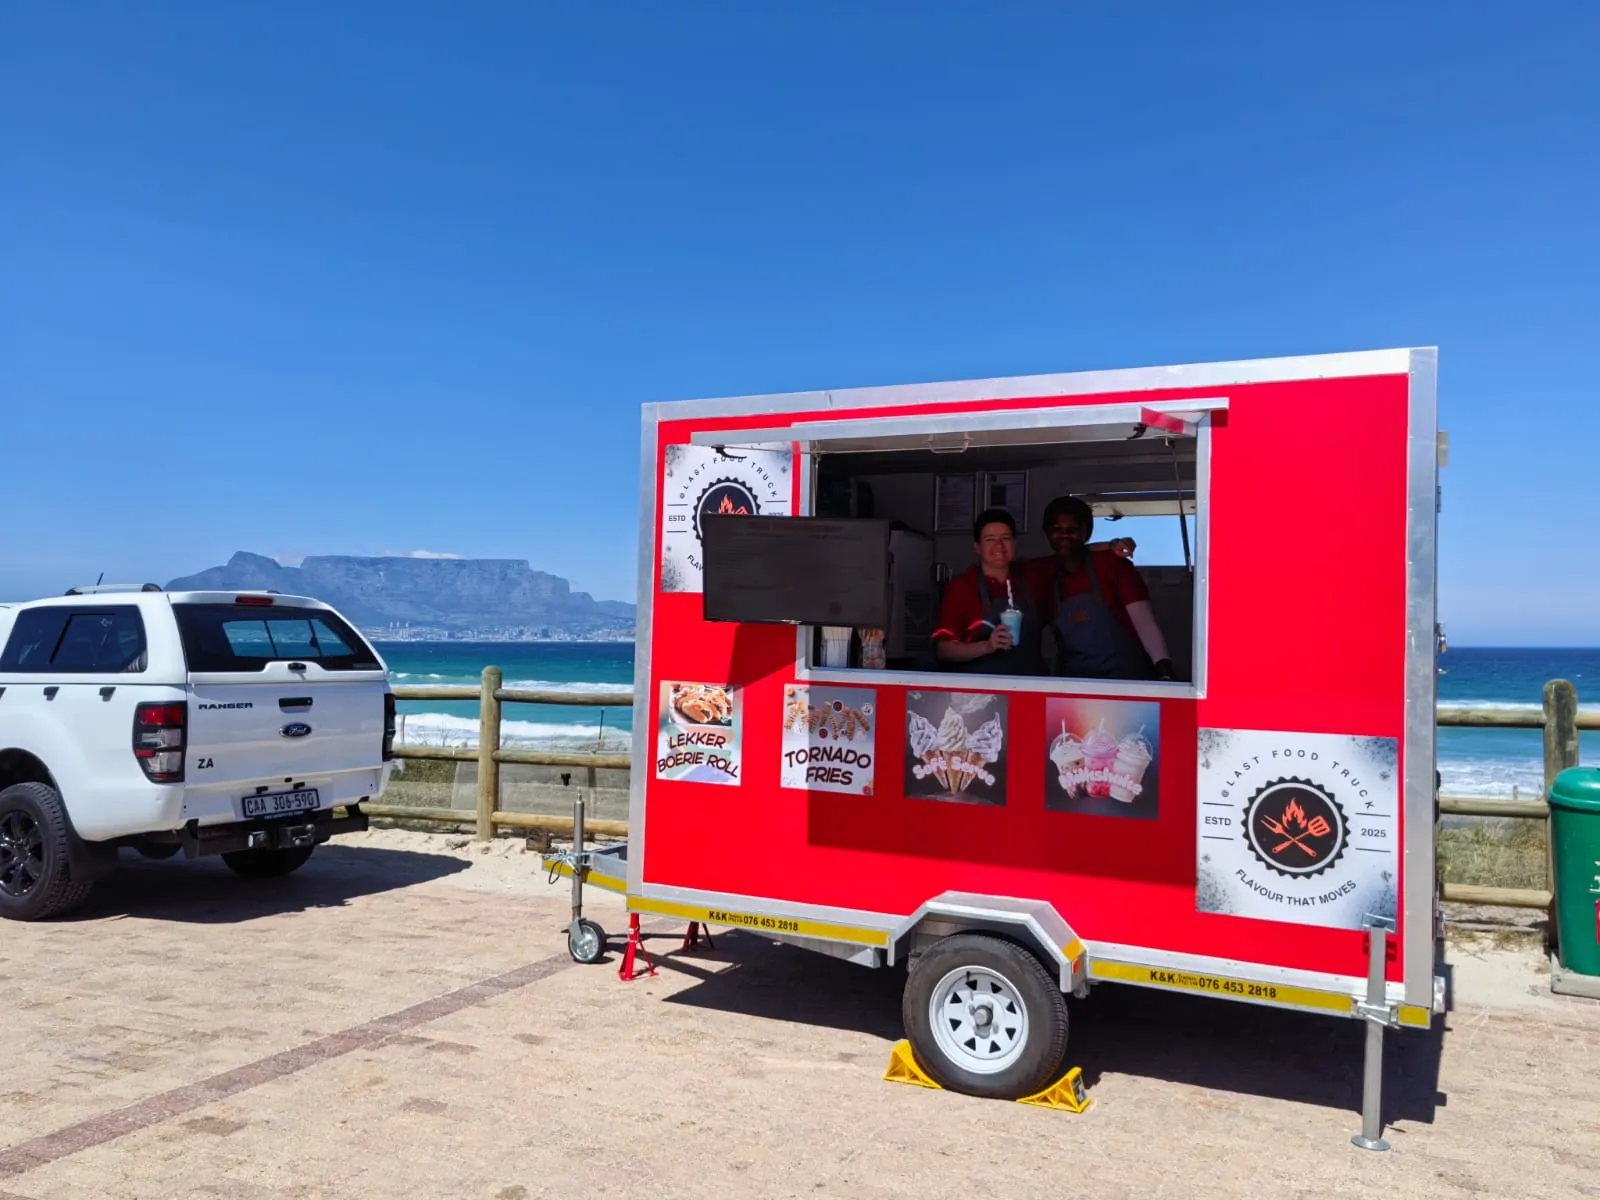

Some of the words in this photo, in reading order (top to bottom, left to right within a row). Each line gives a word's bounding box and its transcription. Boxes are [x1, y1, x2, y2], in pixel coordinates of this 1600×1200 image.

[751, 462, 777, 497] TRUCK
[198, 702, 254, 710] RANGER
[669, 732, 726, 749] LEKKER
[197, 758, 214, 769] ZA
[657, 751, 705, 773] BOERIE
[706, 754, 739, 778] ROLL
[784, 746, 872, 769] TORNADO
[805, 766, 854, 785] FRIES
[1272, 749, 1319, 761] FOOD
[1331, 761, 1375, 809] TRUCK
[247, 798, 267, 814] CAA
[1204, 816, 1232, 826] ESTD
[1360, 828, 1387, 838] 2025
[1235, 868, 1283, 904] FLAVOUR
[1286, 896, 1316, 906] THAT
[1318, 879, 1357, 905] MOVES
[709, 911, 727, 921] K&K
[743, 915, 758, 926] 076
[761, 918, 776, 929] 453
[778, 920, 799, 931] 2818
[1150, 970, 1175, 984] K&K
[1199, 977, 1220, 989] 076
[1223, 981, 1244, 993] 453
[1248, 984, 1277, 998] 2818
